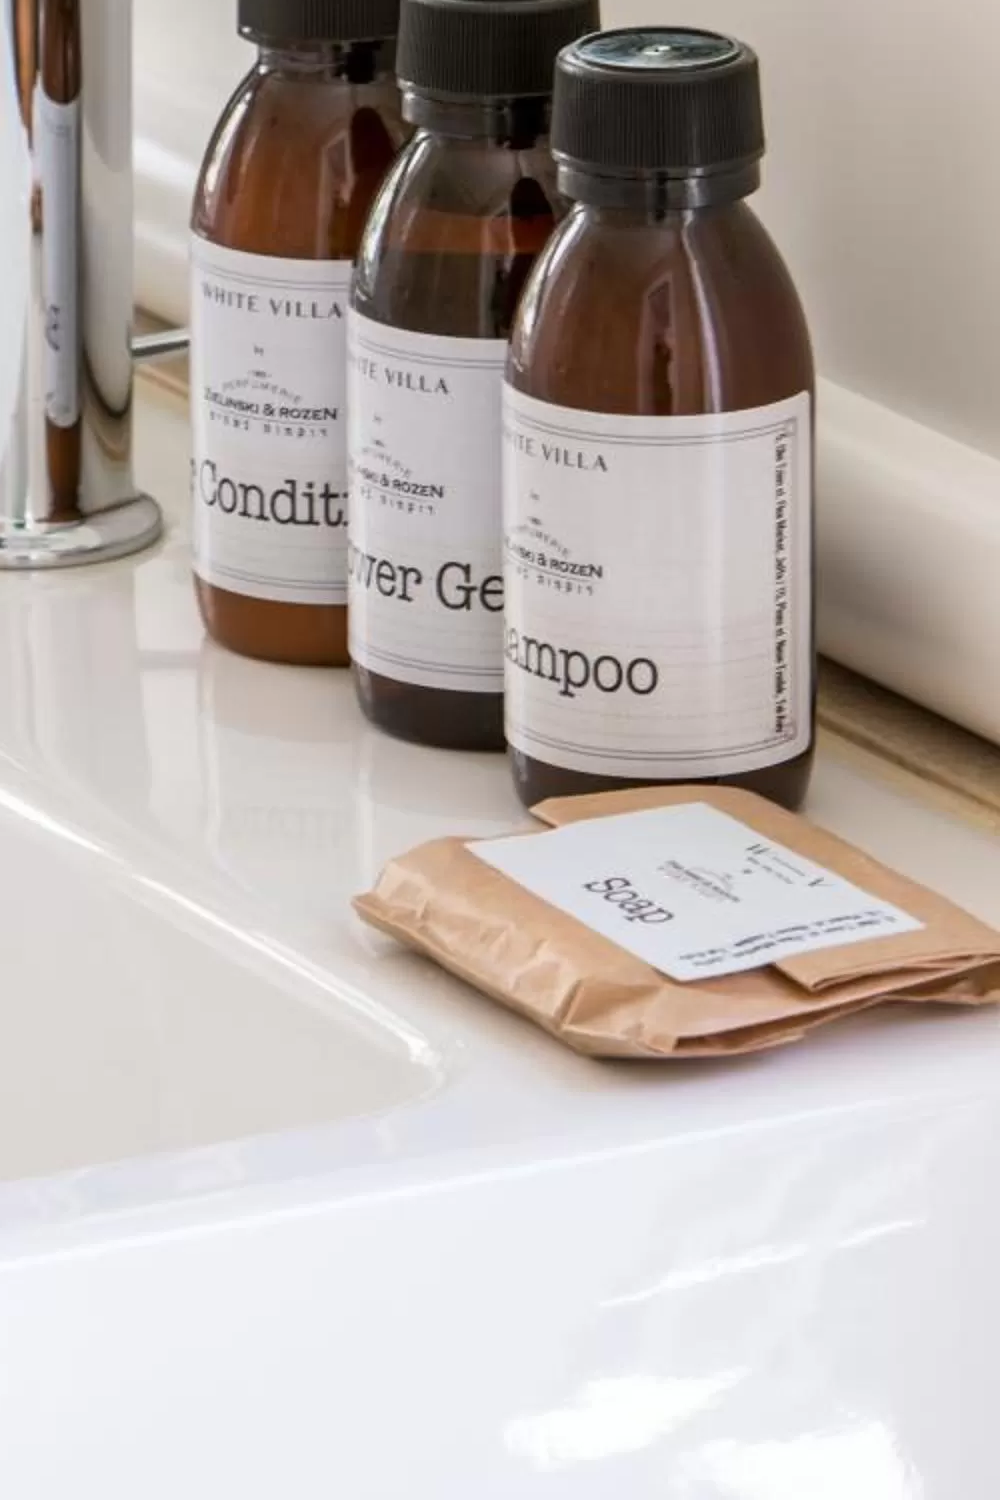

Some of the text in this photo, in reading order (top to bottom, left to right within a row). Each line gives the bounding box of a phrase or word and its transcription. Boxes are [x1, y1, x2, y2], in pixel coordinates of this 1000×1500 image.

[203, 283, 343, 319] WHITE VILLA
[384, 367, 449, 395] VILLA
[279, 407, 338, 421] ROZEN
[541, 443, 608, 473] VILLA
[200, 459, 348, 527] Condit
[392, 479, 444, 499] ROZEN
[550, 558, 603, 579] ROZEN
[436, 561, 505, 612] Ge
[503, 627, 659, 698] ampoo
[582, 876, 675, 924] Soap
